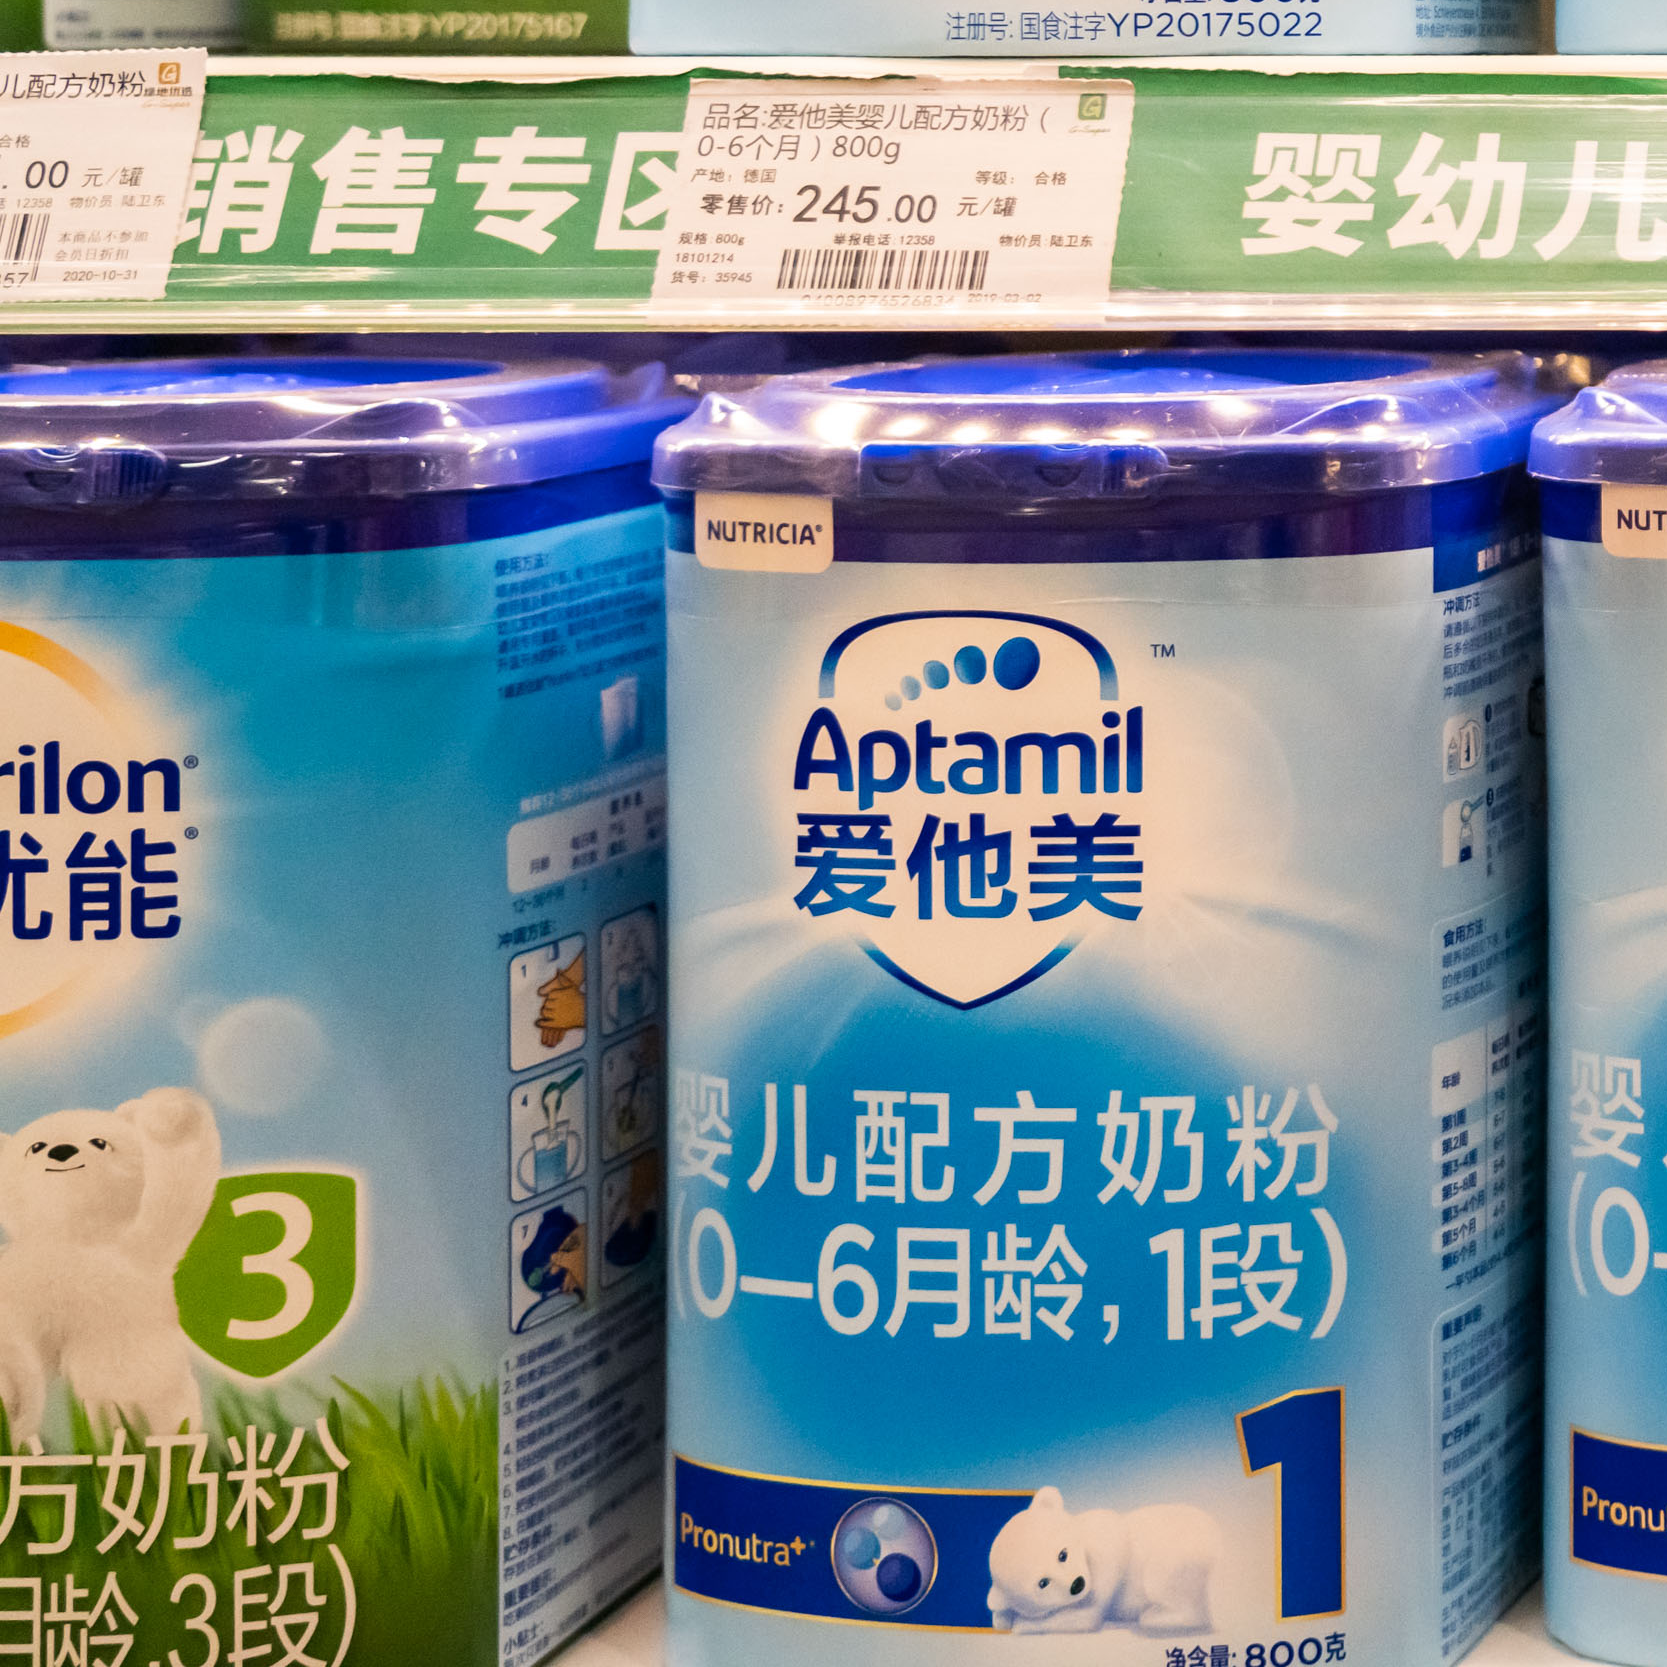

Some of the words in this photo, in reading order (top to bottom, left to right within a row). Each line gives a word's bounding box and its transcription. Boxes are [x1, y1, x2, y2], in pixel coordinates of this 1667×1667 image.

[674, 251, 735, 265] 18101214
[899, 234, 936, 247] 12358
[792, 703, 1144, 812] Aptamil
[792, 812, 1145, 923] 爱他美
[671, 1074, 1341, 1208] 婴儿配方奶粉
[225, 1190, 316, 1341] 3
[1234, 1384, 1347, 1625] 1
